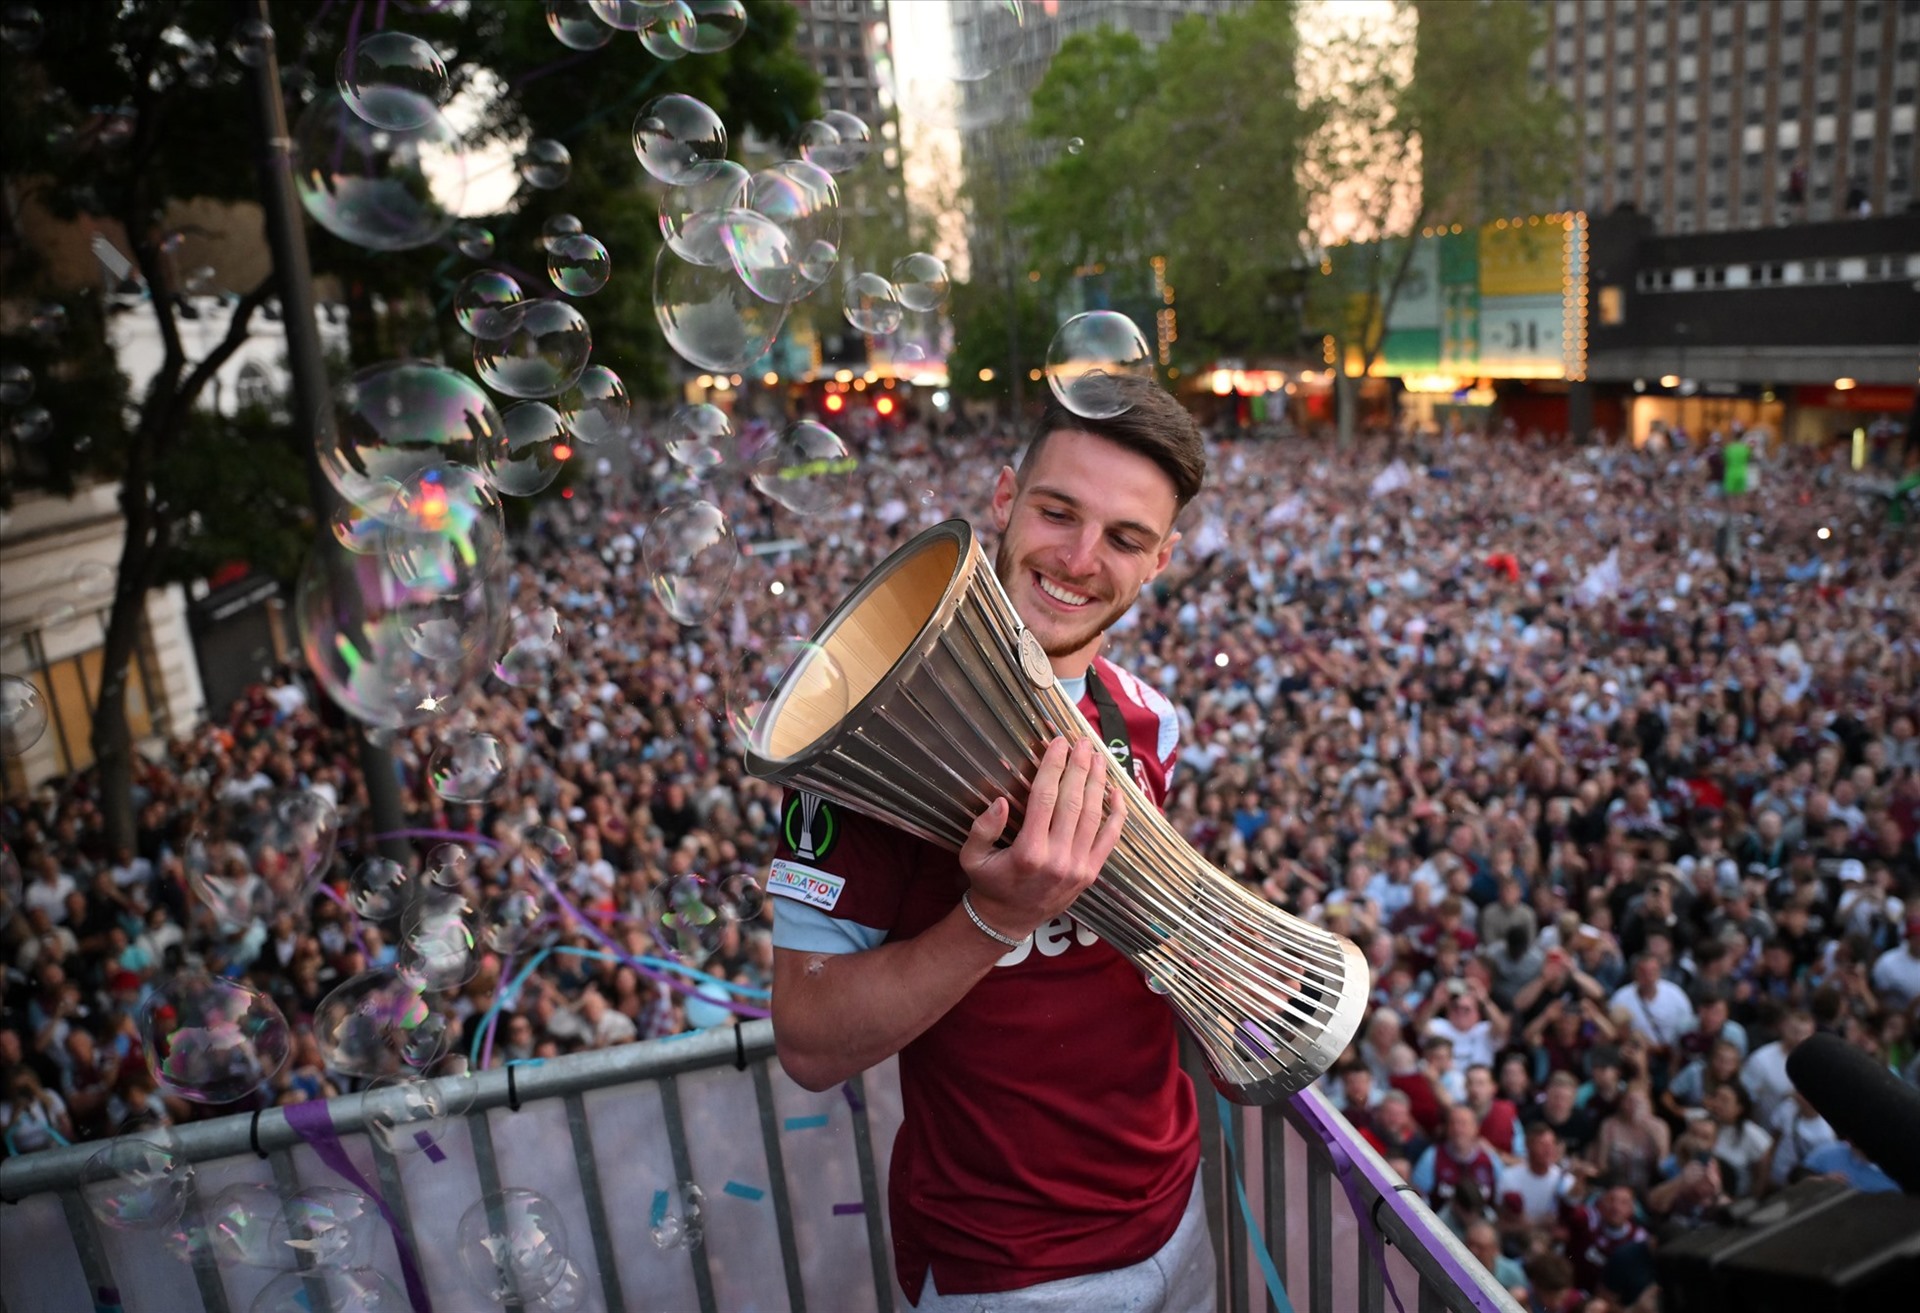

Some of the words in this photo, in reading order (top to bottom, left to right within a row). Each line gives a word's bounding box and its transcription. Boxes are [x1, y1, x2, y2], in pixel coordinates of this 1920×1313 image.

[770, 869, 839, 900] FOUNDATION
[804, 893, 813, 901] for
[813, 896, 833, 907] children
